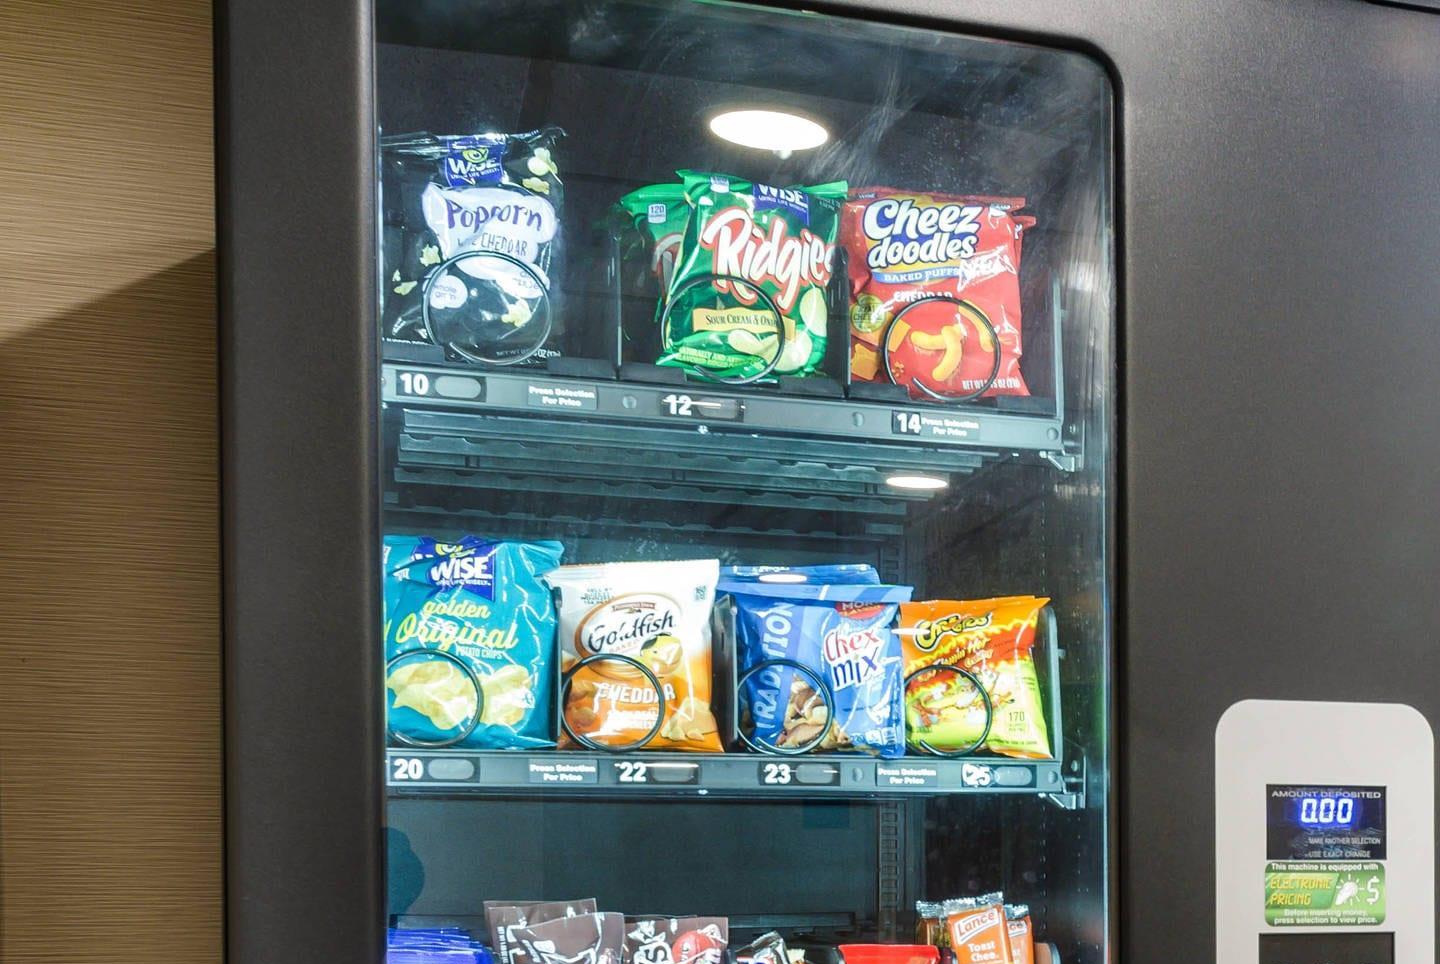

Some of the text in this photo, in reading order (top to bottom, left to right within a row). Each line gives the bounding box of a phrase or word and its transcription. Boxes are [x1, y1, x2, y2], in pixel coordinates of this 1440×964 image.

[758, 184, 808, 204] WISE
[446, 200, 543, 233] Popcorn
[864, 199, 981, 240] Cheez
[480, 232, 528, 257] CHEDDAR
[868, 232, 977, 268] doodles
[884, 272, 922, 282] BAKED
[706, 314, 750, 325] SOUR CREAM
[400, 373, 429, 395] 10
[555, 388, 595, 400] Selection
[559, 396, 582, 407] Price
[665, 394, 692, 416] 12
[896, 413, 922, 434] 14
[430, 557, 493, 581] WISE
[422, 601, 491, 619] golden
[395, 613, 519, 652] Original
[587, 610, 673, 653] Goldfish
[825, 630, 880, 662] Chex
[754, 602, 795, 729] TRADTION
[833, 647, 879, 688] mix
[1009, 712, 1025, 722] 170
[394, 758, 424, 780] 20
[556, 764, 596, 773] Selection
[560, 773, 583, 782] Price
[619, 762, 647, 783] 22
[763, 763, 792, 785] 23
[1271, 790, 1381, 799] AMOUNT DEPOSITED
[1272, 863, 1287, 871] This
[1288, 863, 1319, 871] machine
[1328, 864, 1362, 872] equipped
[1270, 878, 1333, 889] ELECTRONIC
[1269, 892, 1312, 906] PRICING
[958, 912, 995, 936] Lance
[968, 941, 996, 951] Toast
